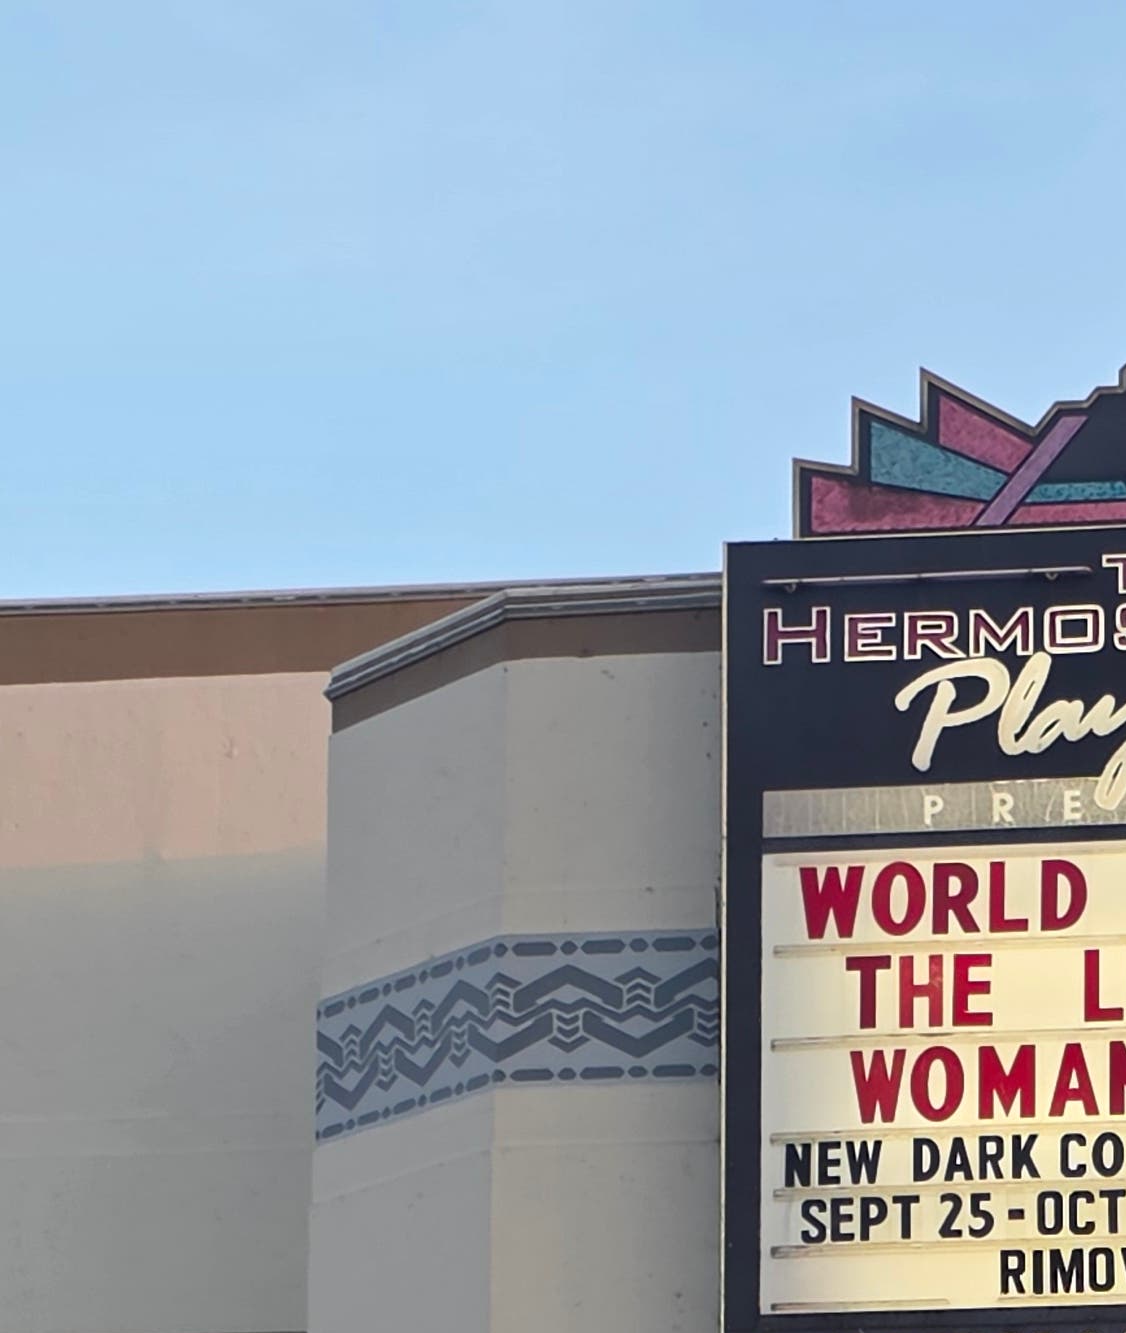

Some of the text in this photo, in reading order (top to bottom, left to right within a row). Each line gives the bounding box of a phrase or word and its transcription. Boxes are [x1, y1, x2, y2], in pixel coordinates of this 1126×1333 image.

[801, 859, 1088, 940] WORLD
[846, 953, 994, 1029] THE
[784, 1140, 882, 1188] NEW
[913, 1133, 1041, 1182] DARK
[800, 1195, 920, 1244] SEPT
